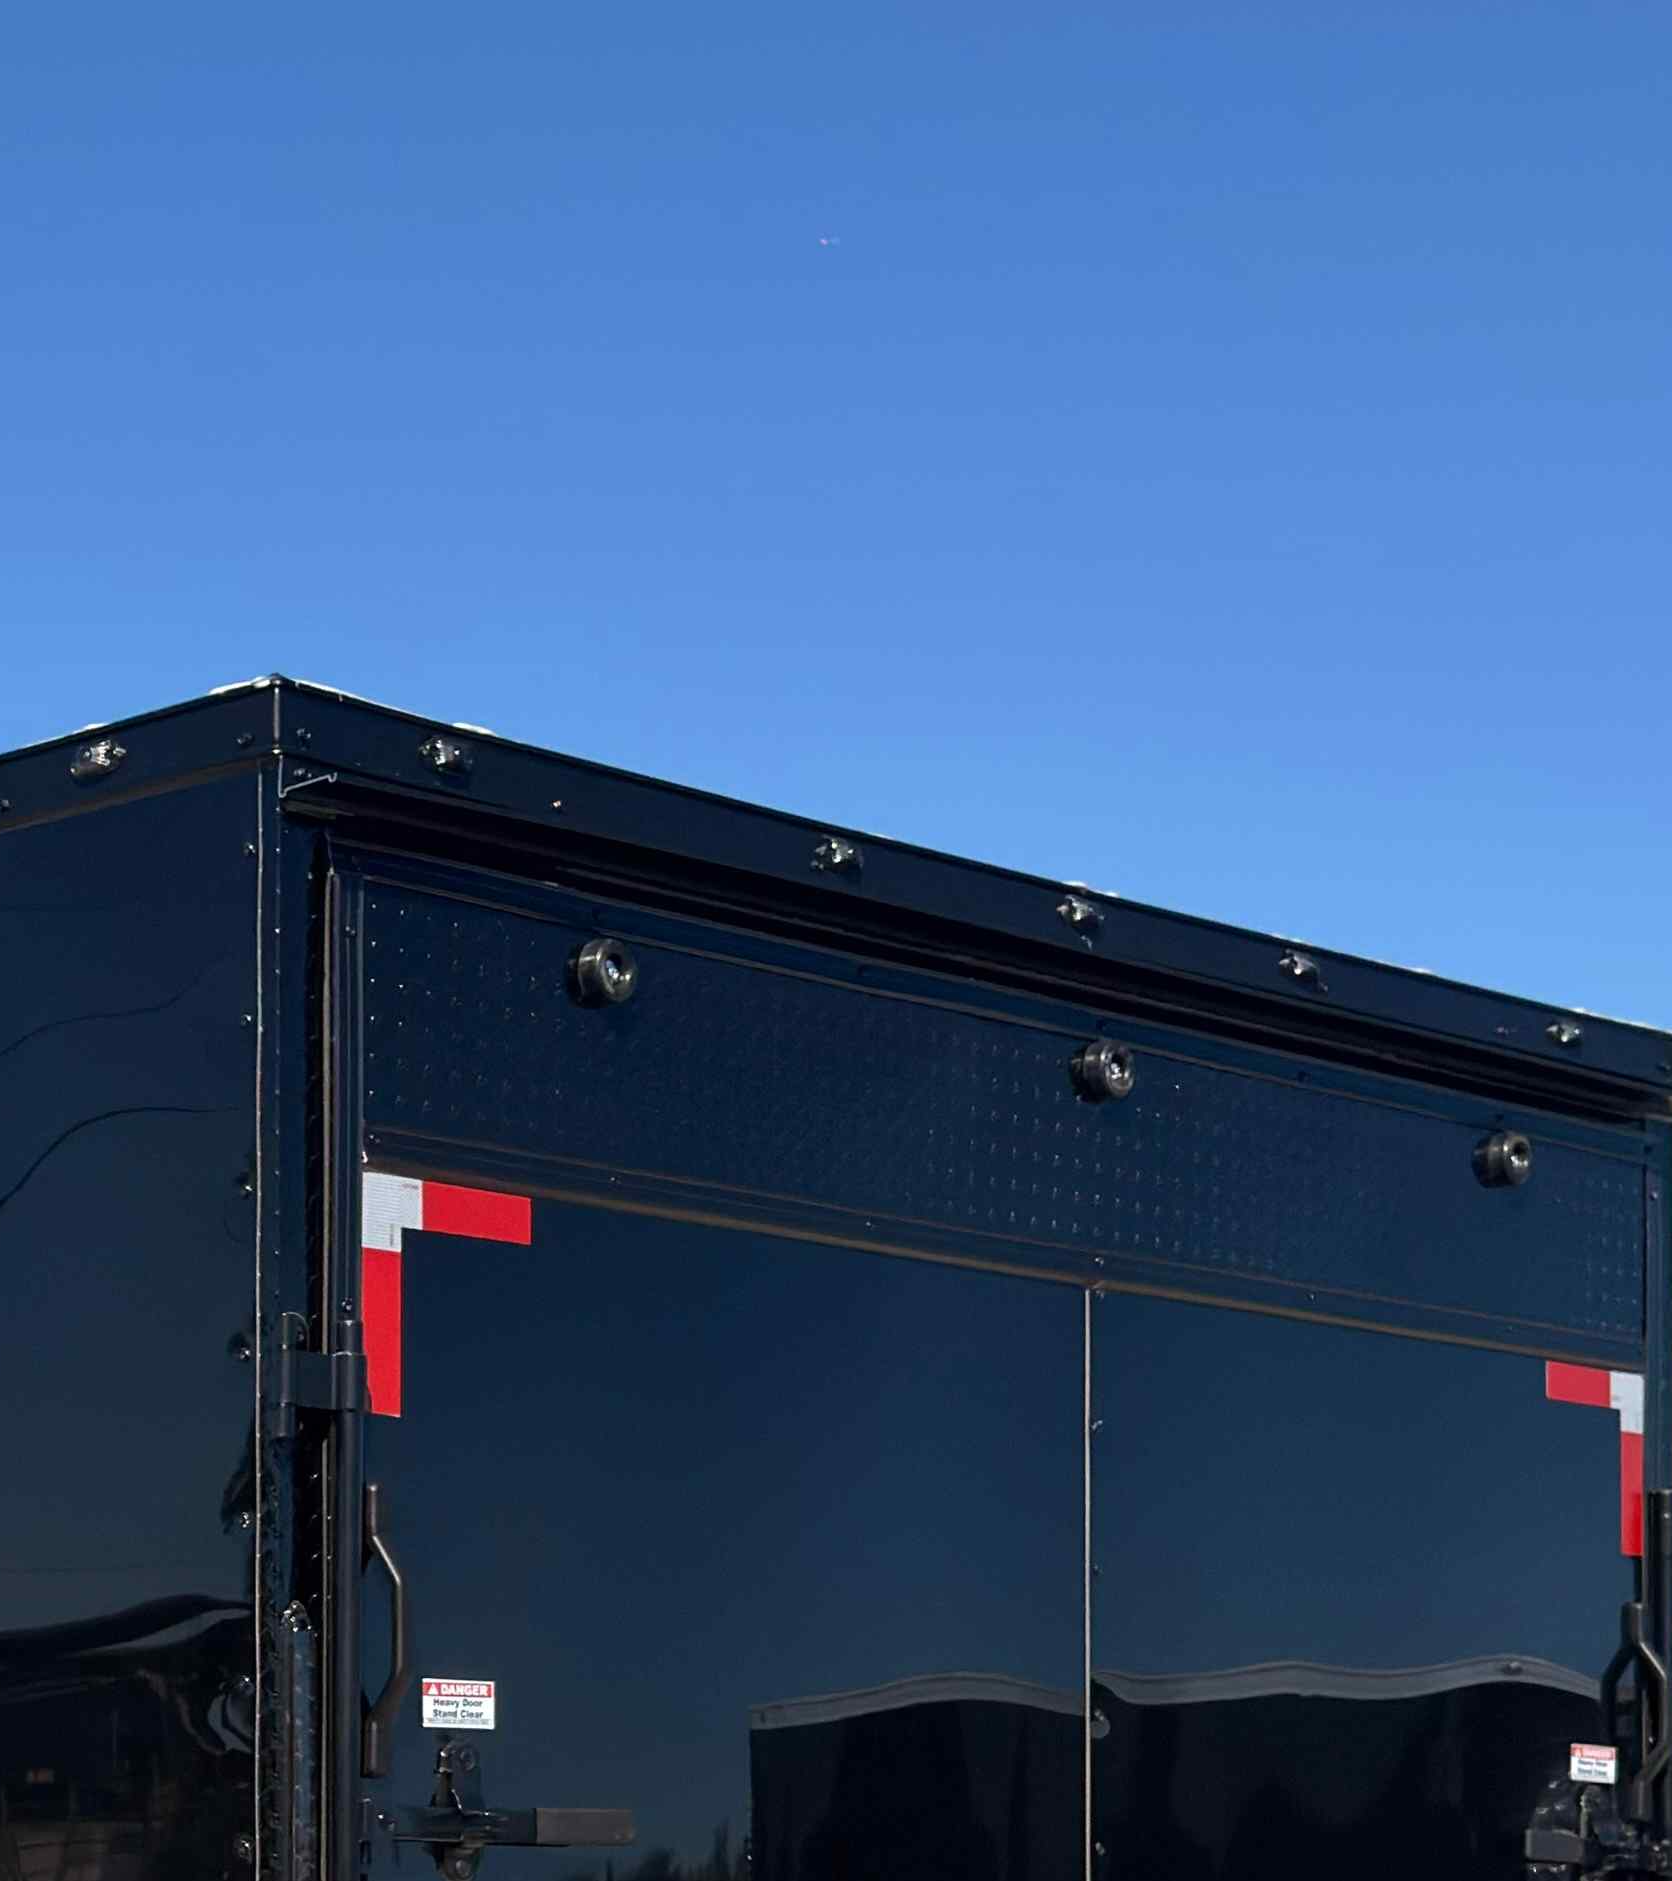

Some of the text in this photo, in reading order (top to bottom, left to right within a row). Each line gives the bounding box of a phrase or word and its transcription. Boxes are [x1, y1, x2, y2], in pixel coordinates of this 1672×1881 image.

[440, 1683, 489, 1696] DANGER
[433, 1698, 484, 1708] Heavy Door
[432, 1708, 484, 1719] Stand Clear
